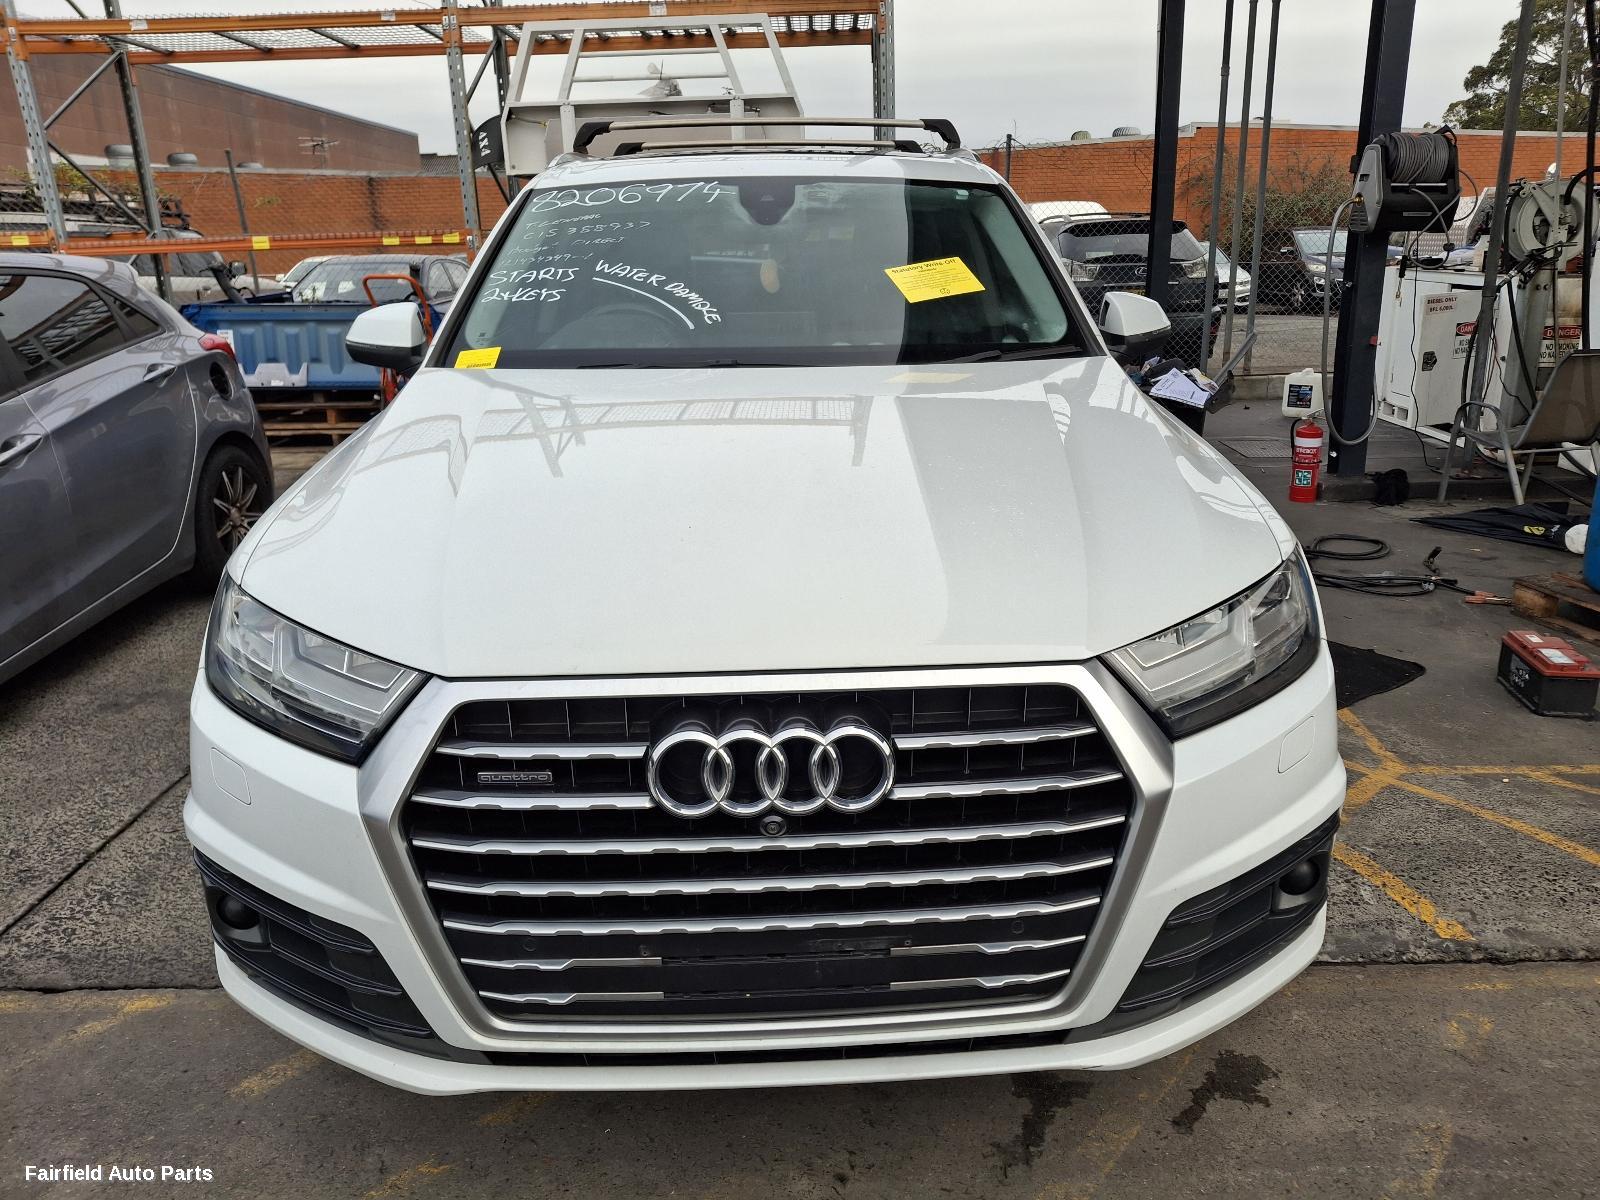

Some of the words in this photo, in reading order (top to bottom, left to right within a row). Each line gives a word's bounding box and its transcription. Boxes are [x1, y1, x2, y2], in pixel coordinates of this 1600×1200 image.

[532, 181, 737, 213] 8206974
[595, 260, 667, 287] WATER
[891, 265, 924, 274] Statutory
[489, 266, 581, 286] STARTS
[1427, 297, 1444, 305] DIESEL
[1547, 328, 1581, 337] DNGER
[1546, 343, 1554, 351] NO
[1555, 342, 1580, 351] MOKING
[480, 773, 548, 782] quattro
